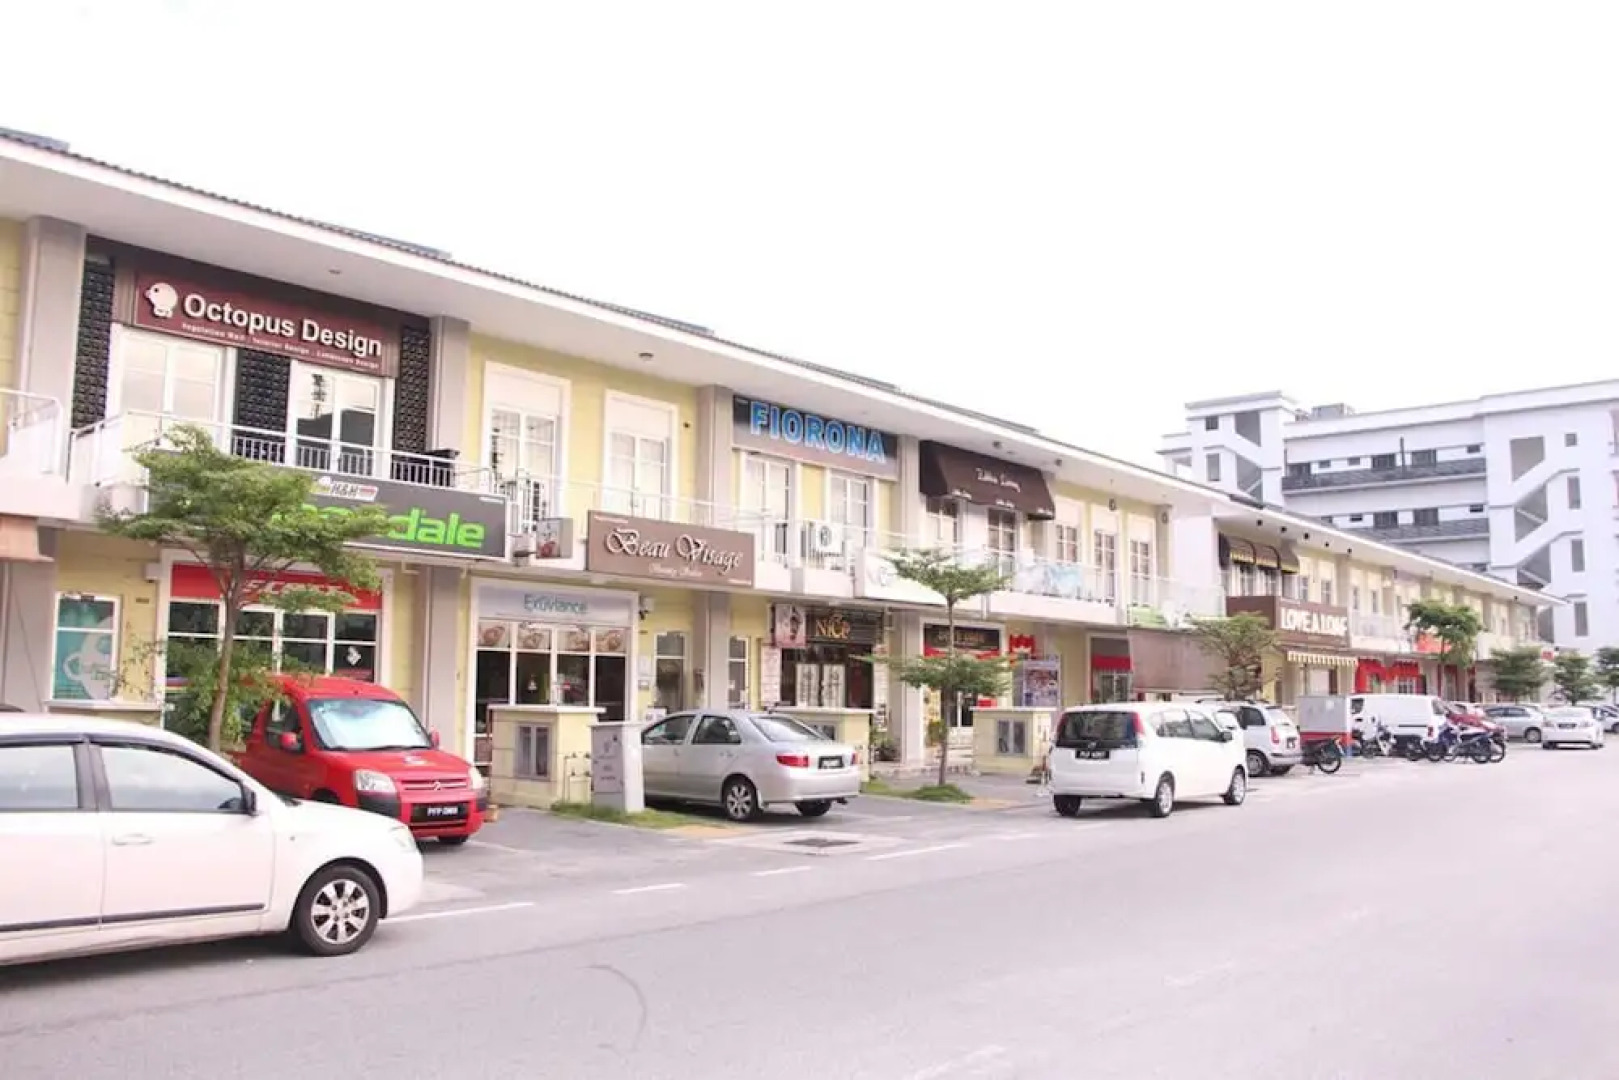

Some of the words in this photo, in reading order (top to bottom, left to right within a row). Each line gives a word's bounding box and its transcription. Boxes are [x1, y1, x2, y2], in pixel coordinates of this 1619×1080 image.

[184, 292, 295, 338] Octopus
[302, 318, 382, 358] Design
[750, 401, 886, 463] FIORONA
[606, 527, 672, 560] Beau
[676, 534, 745, 577] Visage
[1280, 607, 1312, 632] LOVE
